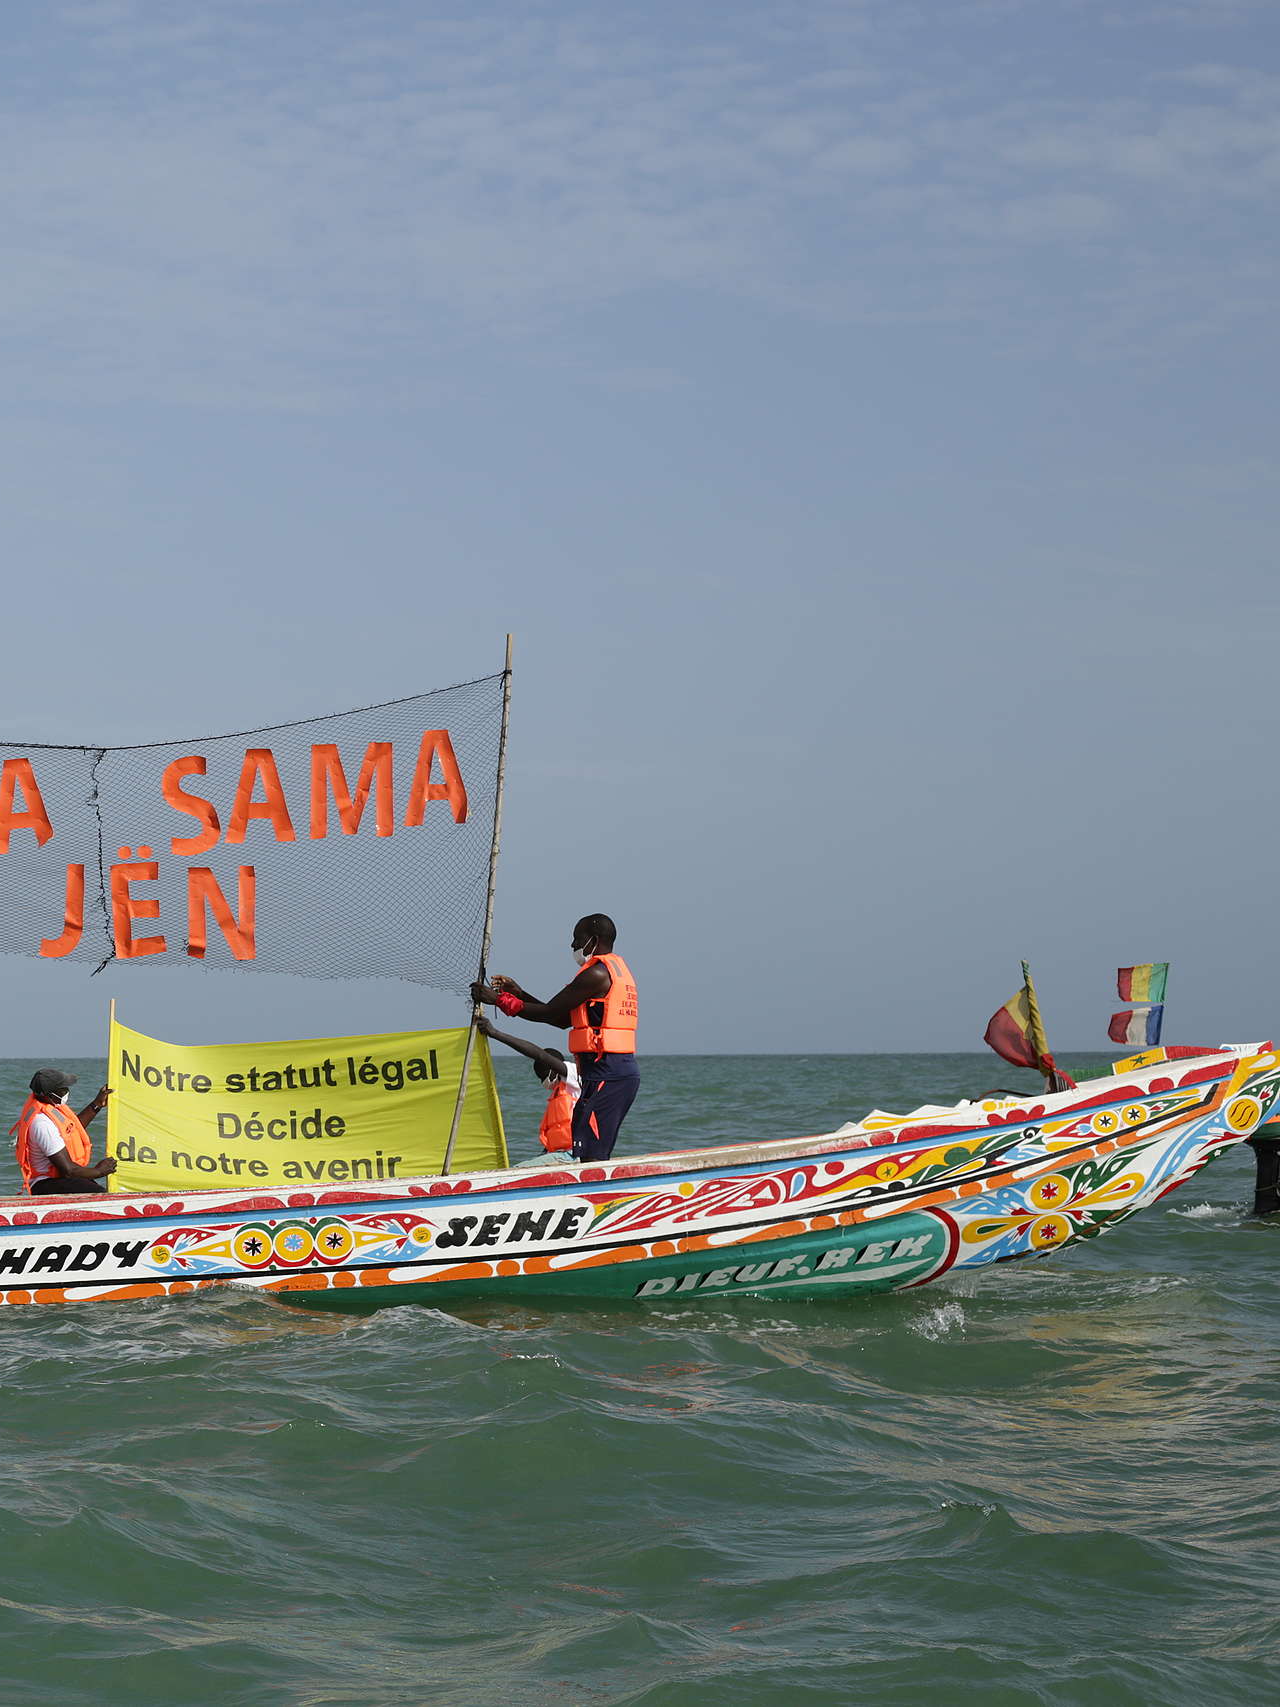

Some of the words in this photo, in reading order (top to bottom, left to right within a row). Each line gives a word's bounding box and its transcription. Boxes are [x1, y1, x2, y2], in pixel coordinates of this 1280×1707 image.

[162, 730, 468, 857] SAMA
[40, 846, 257, 960] JËN
[121, 1050, 212, 1093] Notre
[225, 1058, 337, 1094] statut
[347, 1049, 440, 1091] légal
[216, 1108, 347, 1141] Décide
[117, 1136, 158, 1164] de
[171, 1150, 270, 1178] notre
[282, 1150, 402, 1181] avenir
